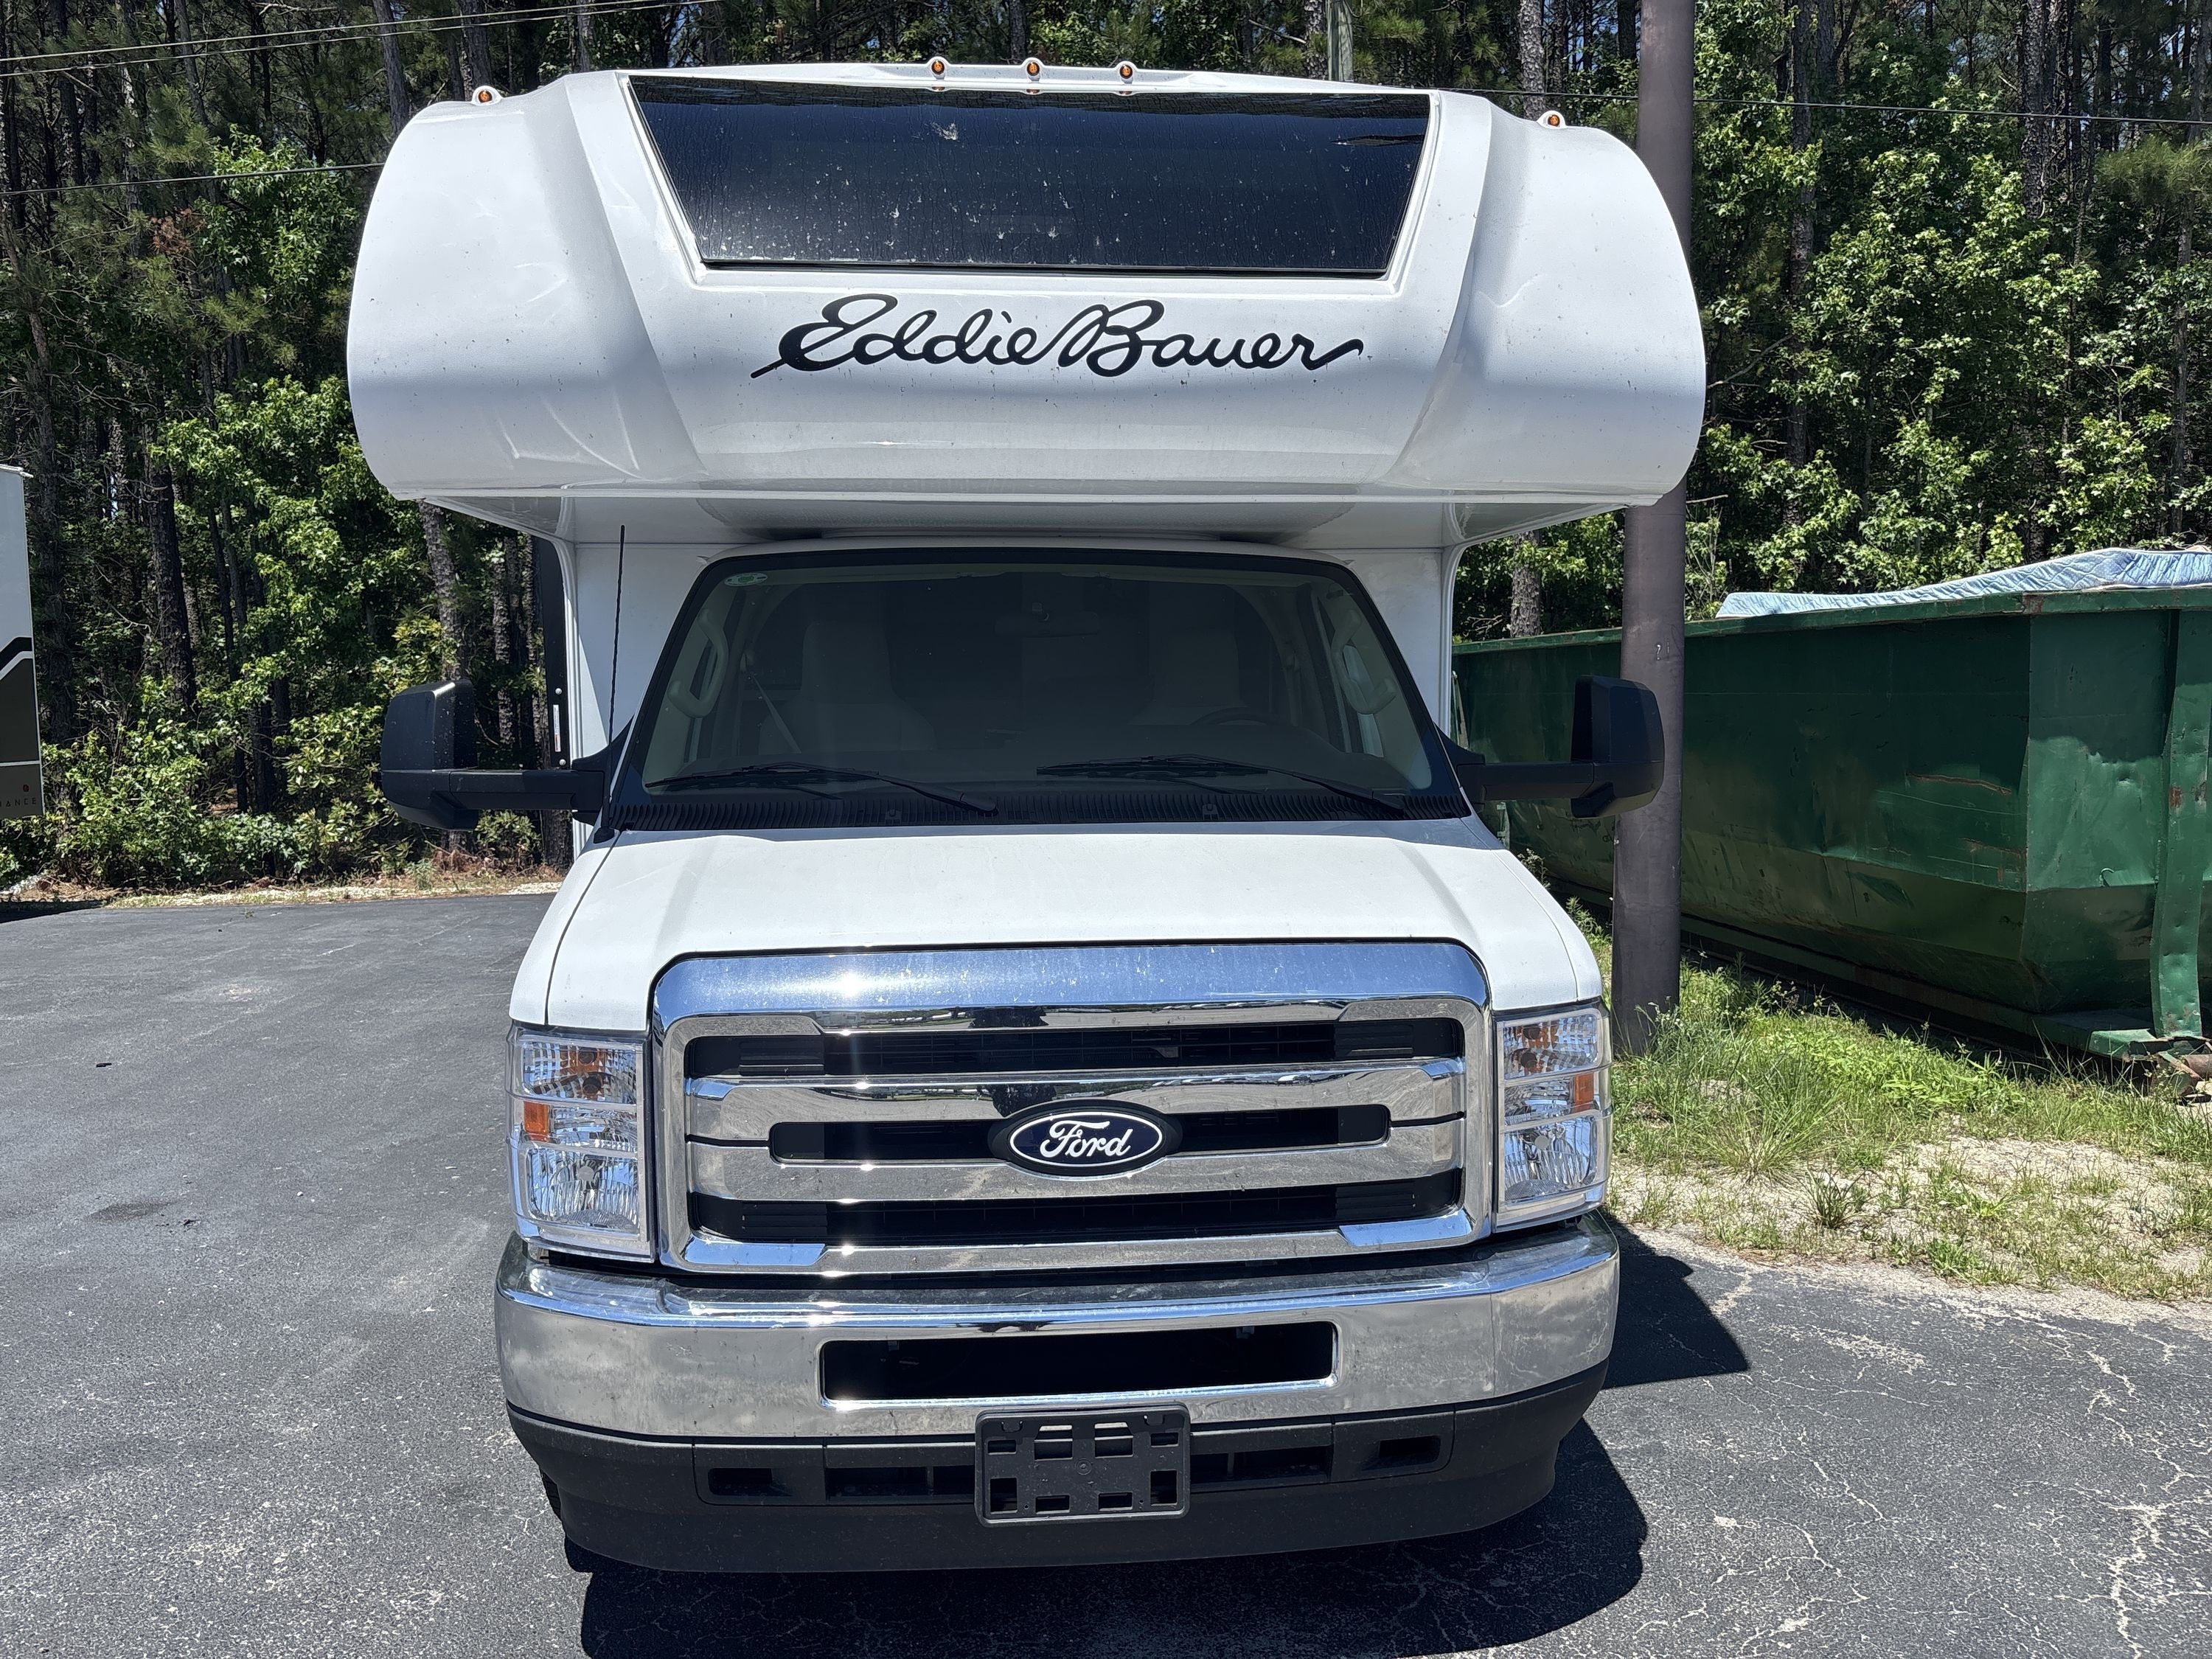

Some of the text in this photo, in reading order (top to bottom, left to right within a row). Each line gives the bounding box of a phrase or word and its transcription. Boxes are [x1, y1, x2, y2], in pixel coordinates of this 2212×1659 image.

[751, 293, 1363, 378] Eddie Bauer
[1040, 1120, 1133, 1158] Ford
